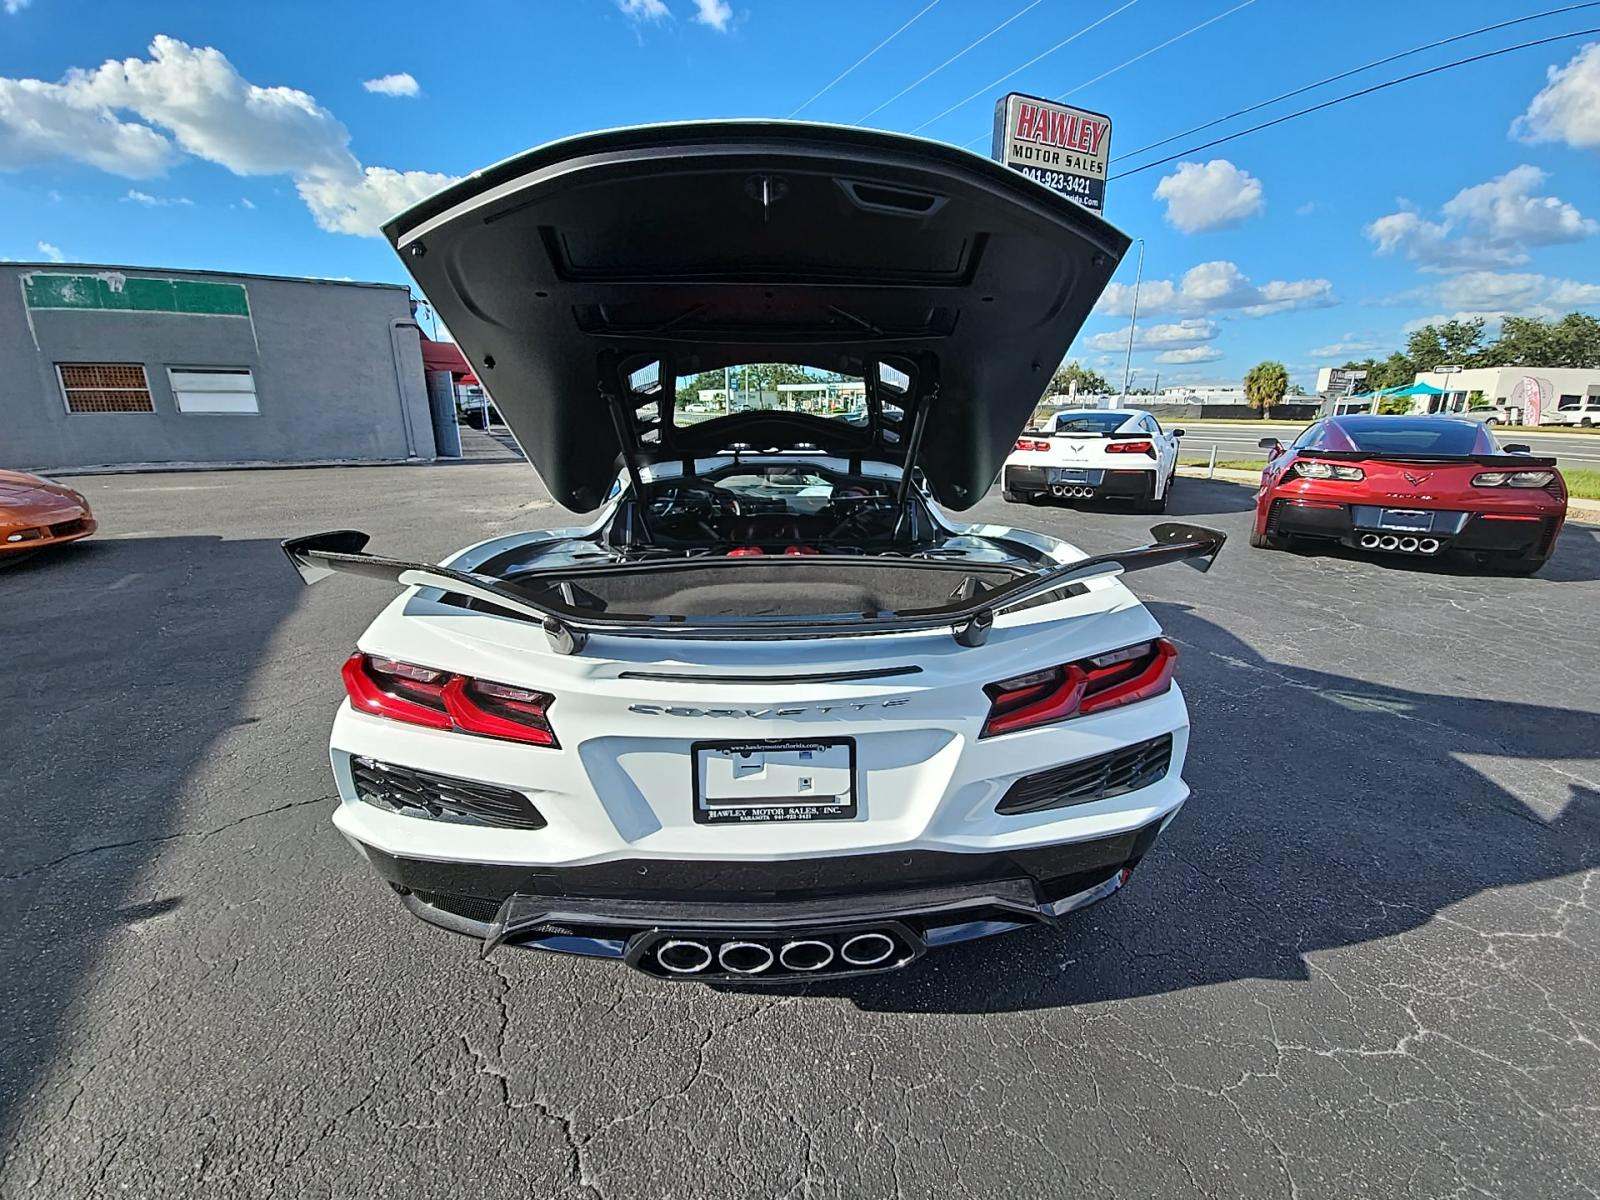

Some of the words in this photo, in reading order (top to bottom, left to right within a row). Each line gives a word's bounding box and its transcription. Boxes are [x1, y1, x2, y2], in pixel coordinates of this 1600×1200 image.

[1014, 102, 1108, 157] HAWLEY
[1012, 144, 1060, 165] MOTOR
[1065, 155, 1103, 174] SALES
[627, 697, 911, 719] CORVETTE
[708, 809, 748, 819] HAWLEY
[752, 808, 784, 816] MOTOR
[789, 807, 819, 815] SALES,
[823, 806, 842, 814] INC.
